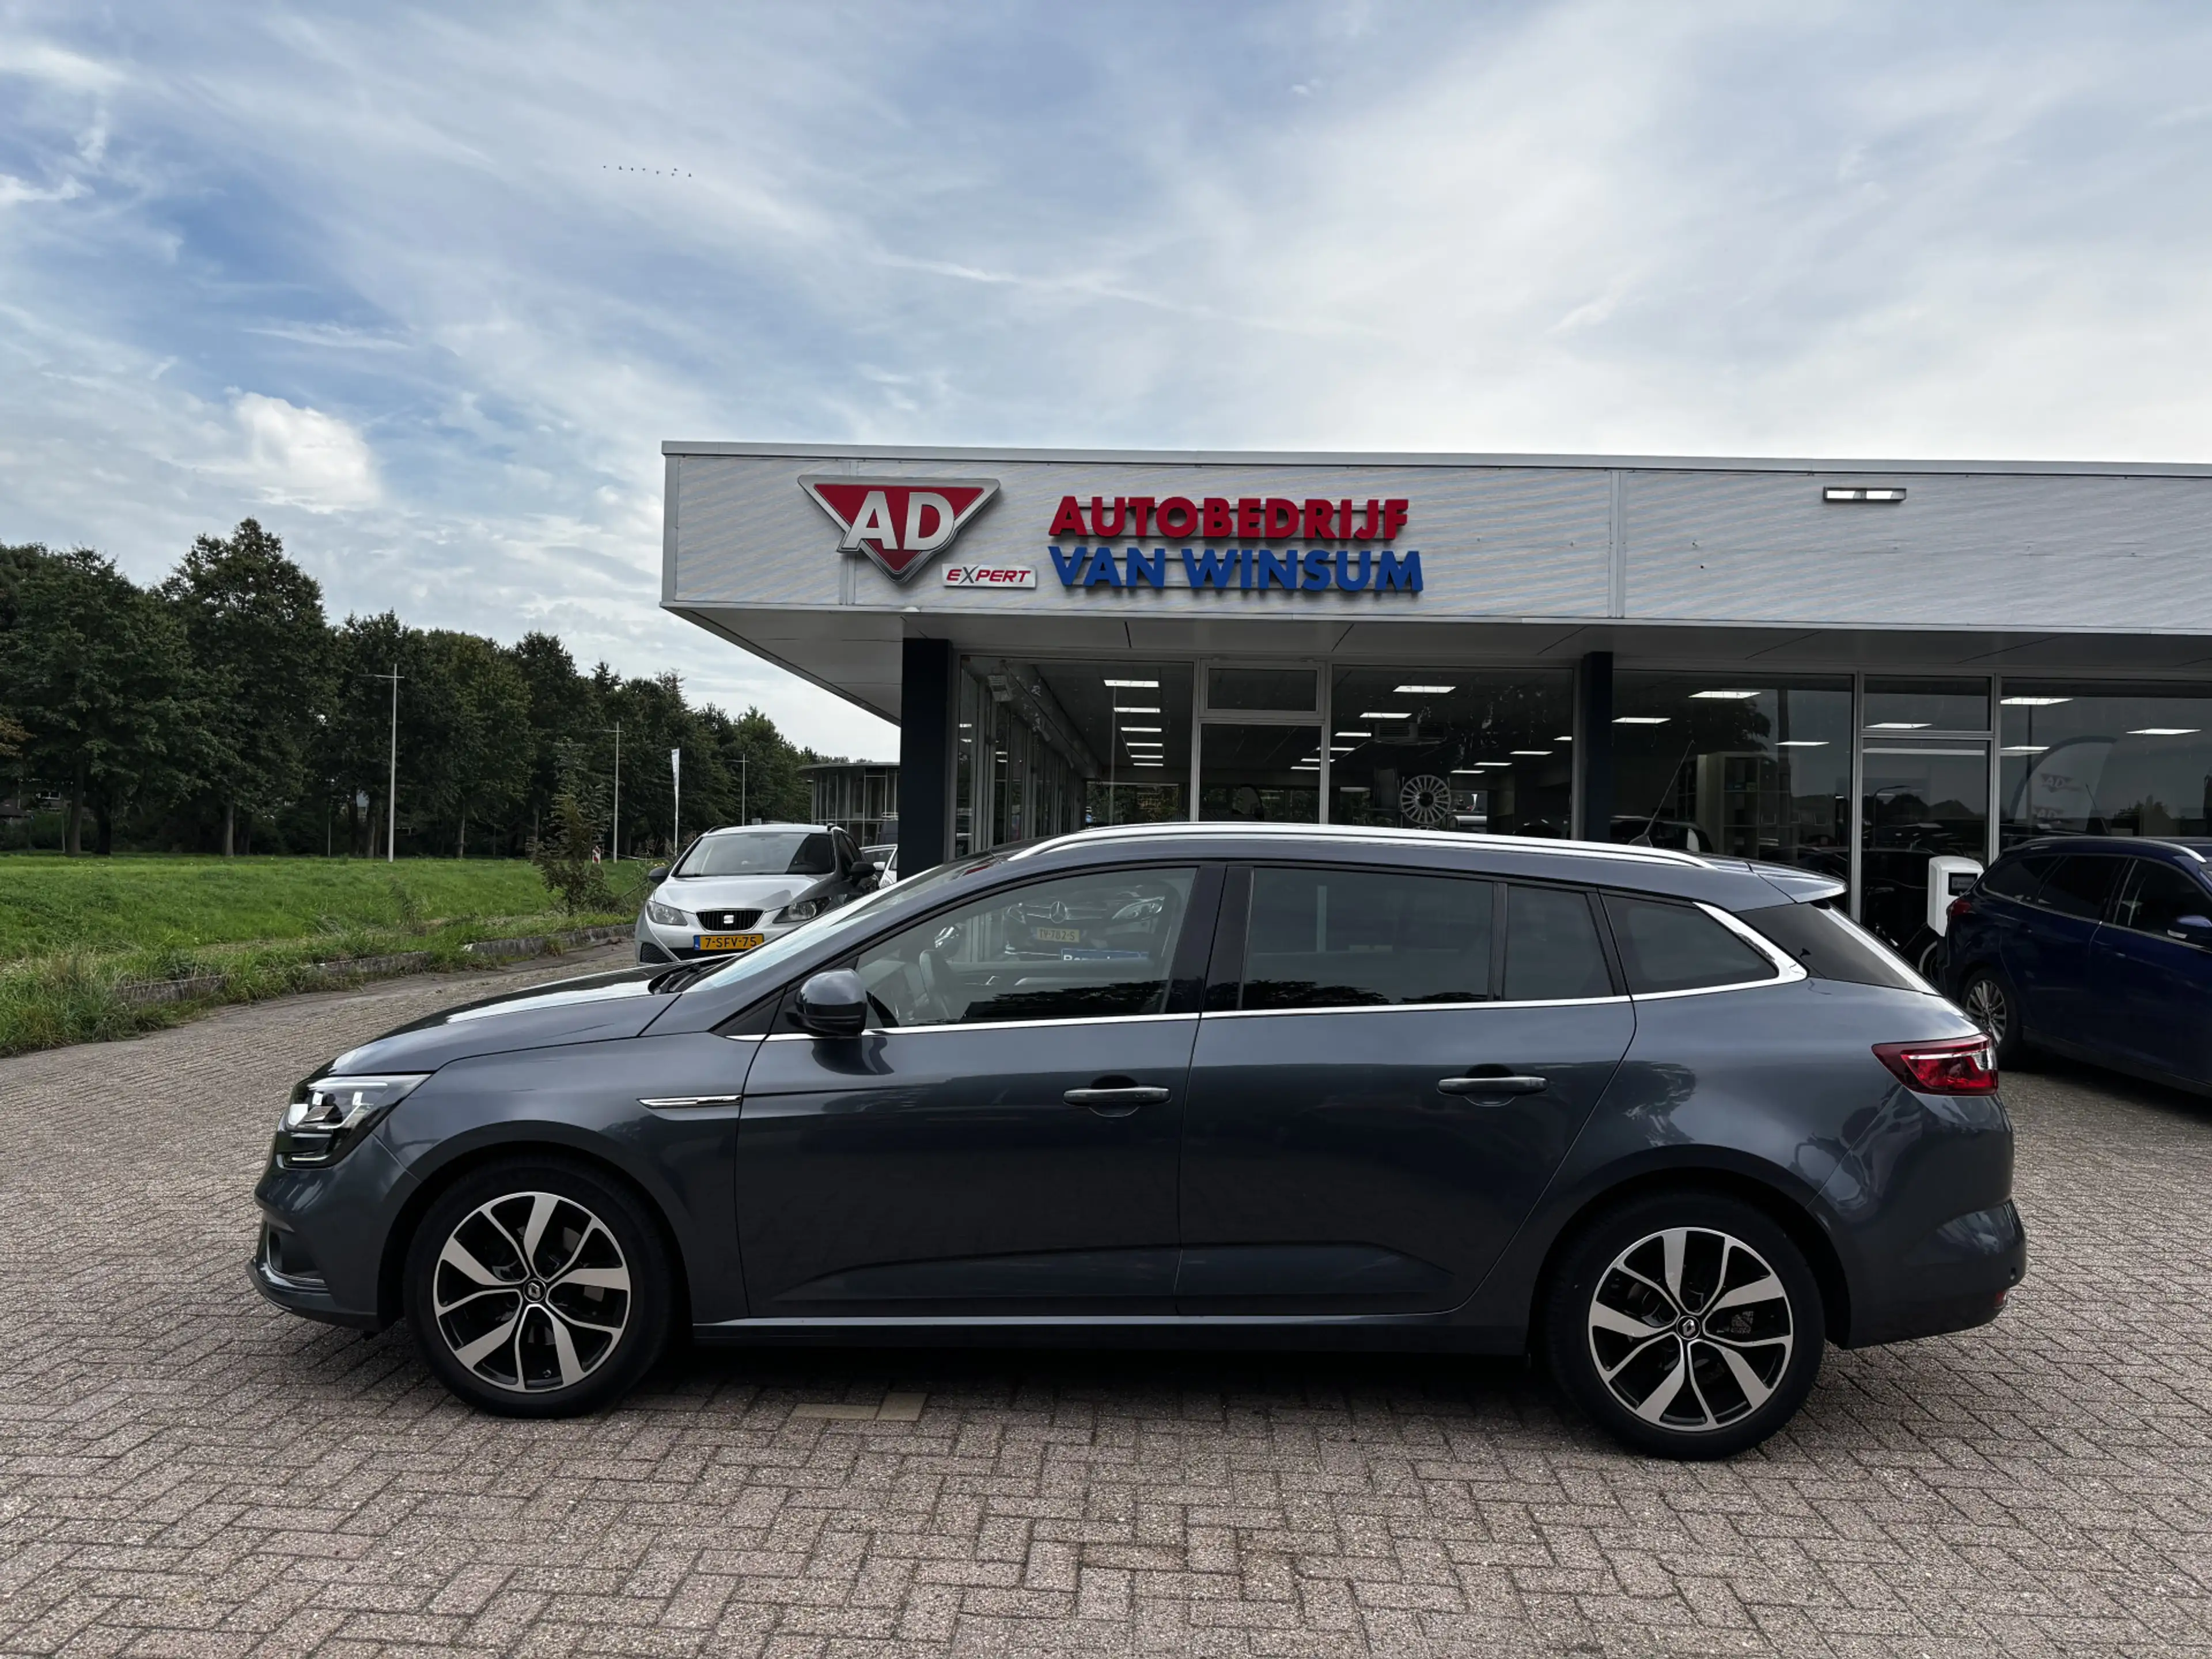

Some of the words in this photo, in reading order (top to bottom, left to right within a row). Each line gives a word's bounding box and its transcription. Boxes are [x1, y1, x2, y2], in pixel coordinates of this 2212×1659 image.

[842, 490, 955, 551] AD
[1048, 495, 1409, 539] AUTOBEDRIJF
[946, 565, 1031, 585] EXPERT
[1047, 546, 1165, 589] VAN
[1181, 548, 1423, 592] WINSUM
[704, 936, 757, 948] 7-SFV-75
